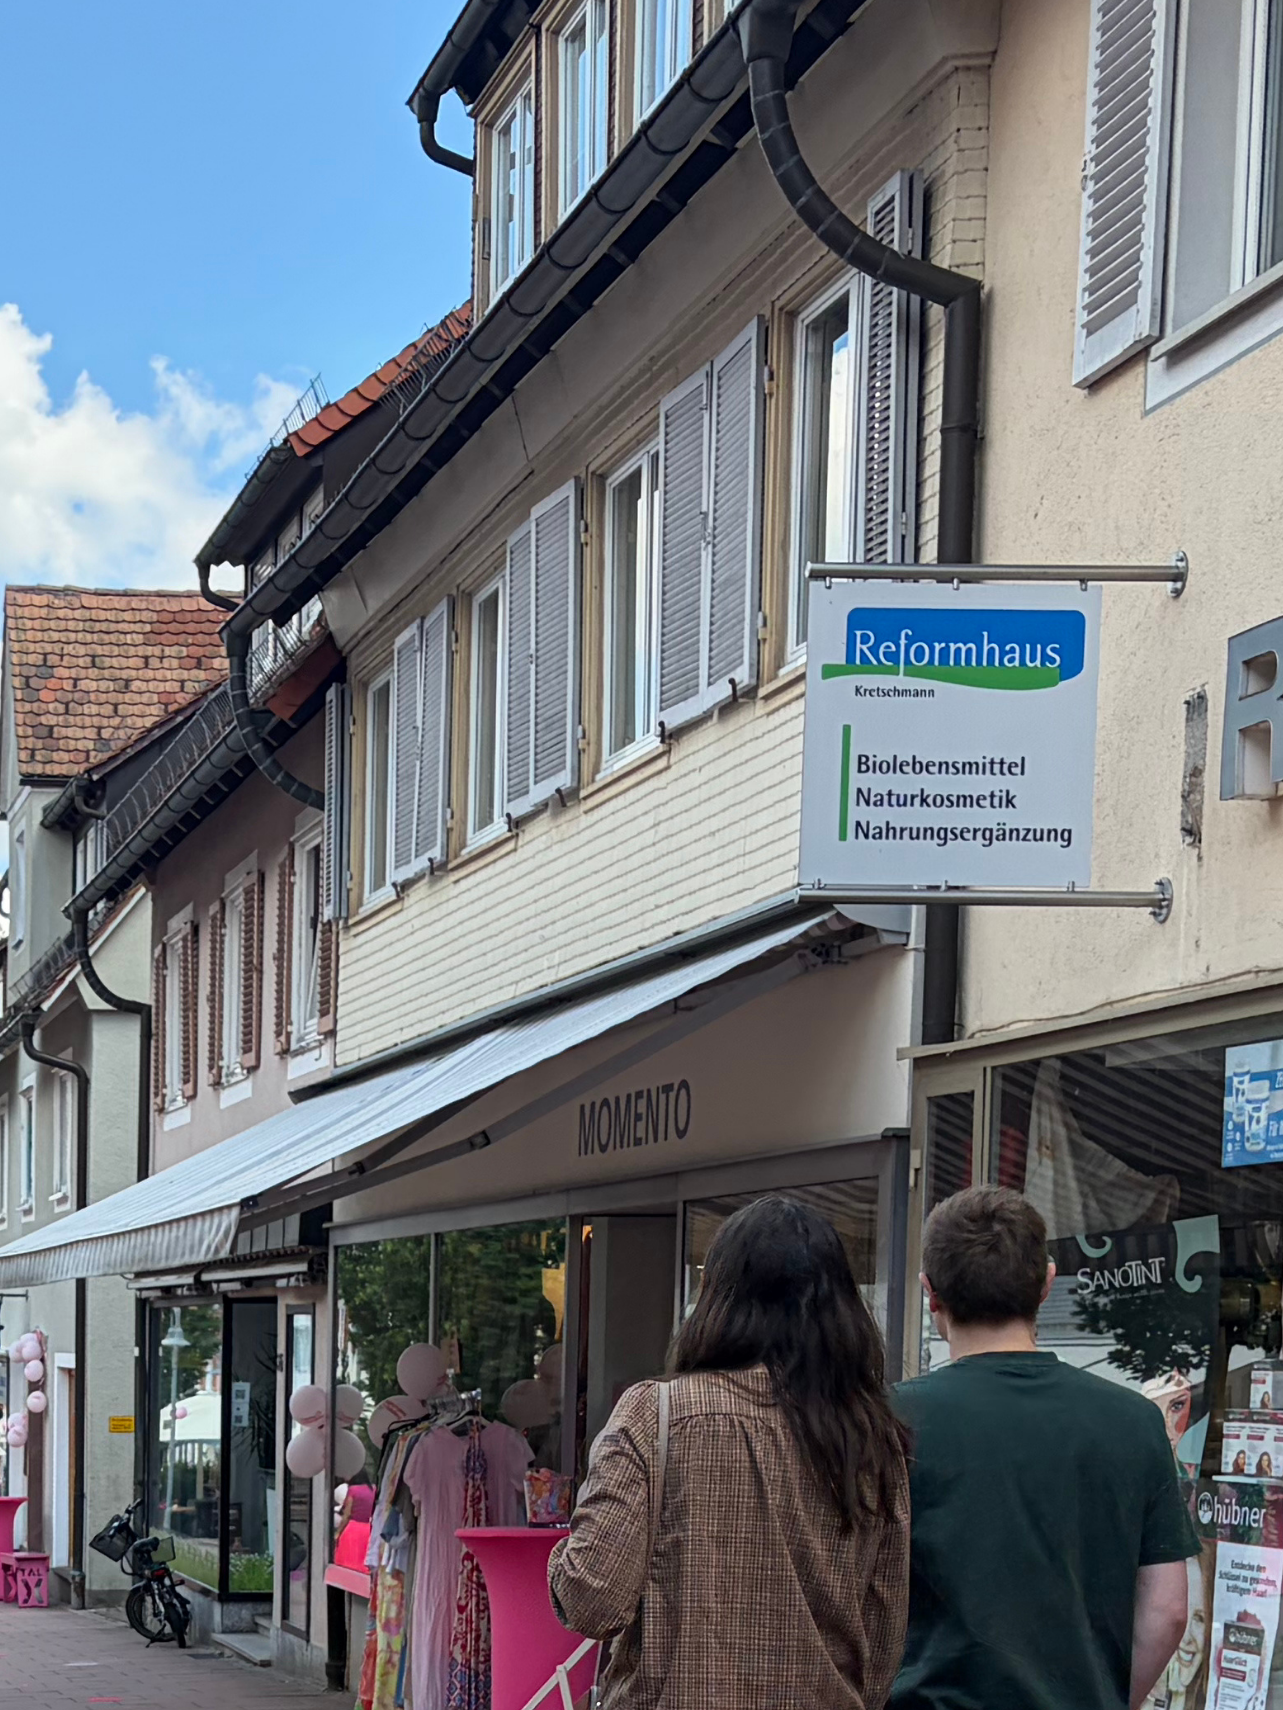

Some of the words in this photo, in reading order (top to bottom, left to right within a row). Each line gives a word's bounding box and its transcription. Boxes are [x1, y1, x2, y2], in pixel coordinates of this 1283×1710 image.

[853, 628, 1062, 677] Reformhaus
[854, 685, 936, 699] Kretschmann
[856, 753, 1027, 778] Biolebensmittel
[855, 787, 1018, 811] Naturkosmetik
[854, 820, 1073, 849] Nahrungsergänzung
[577, 1078, 692, 1157] MOMENTO
[1213, 1495, 1267, 1529] hübner
